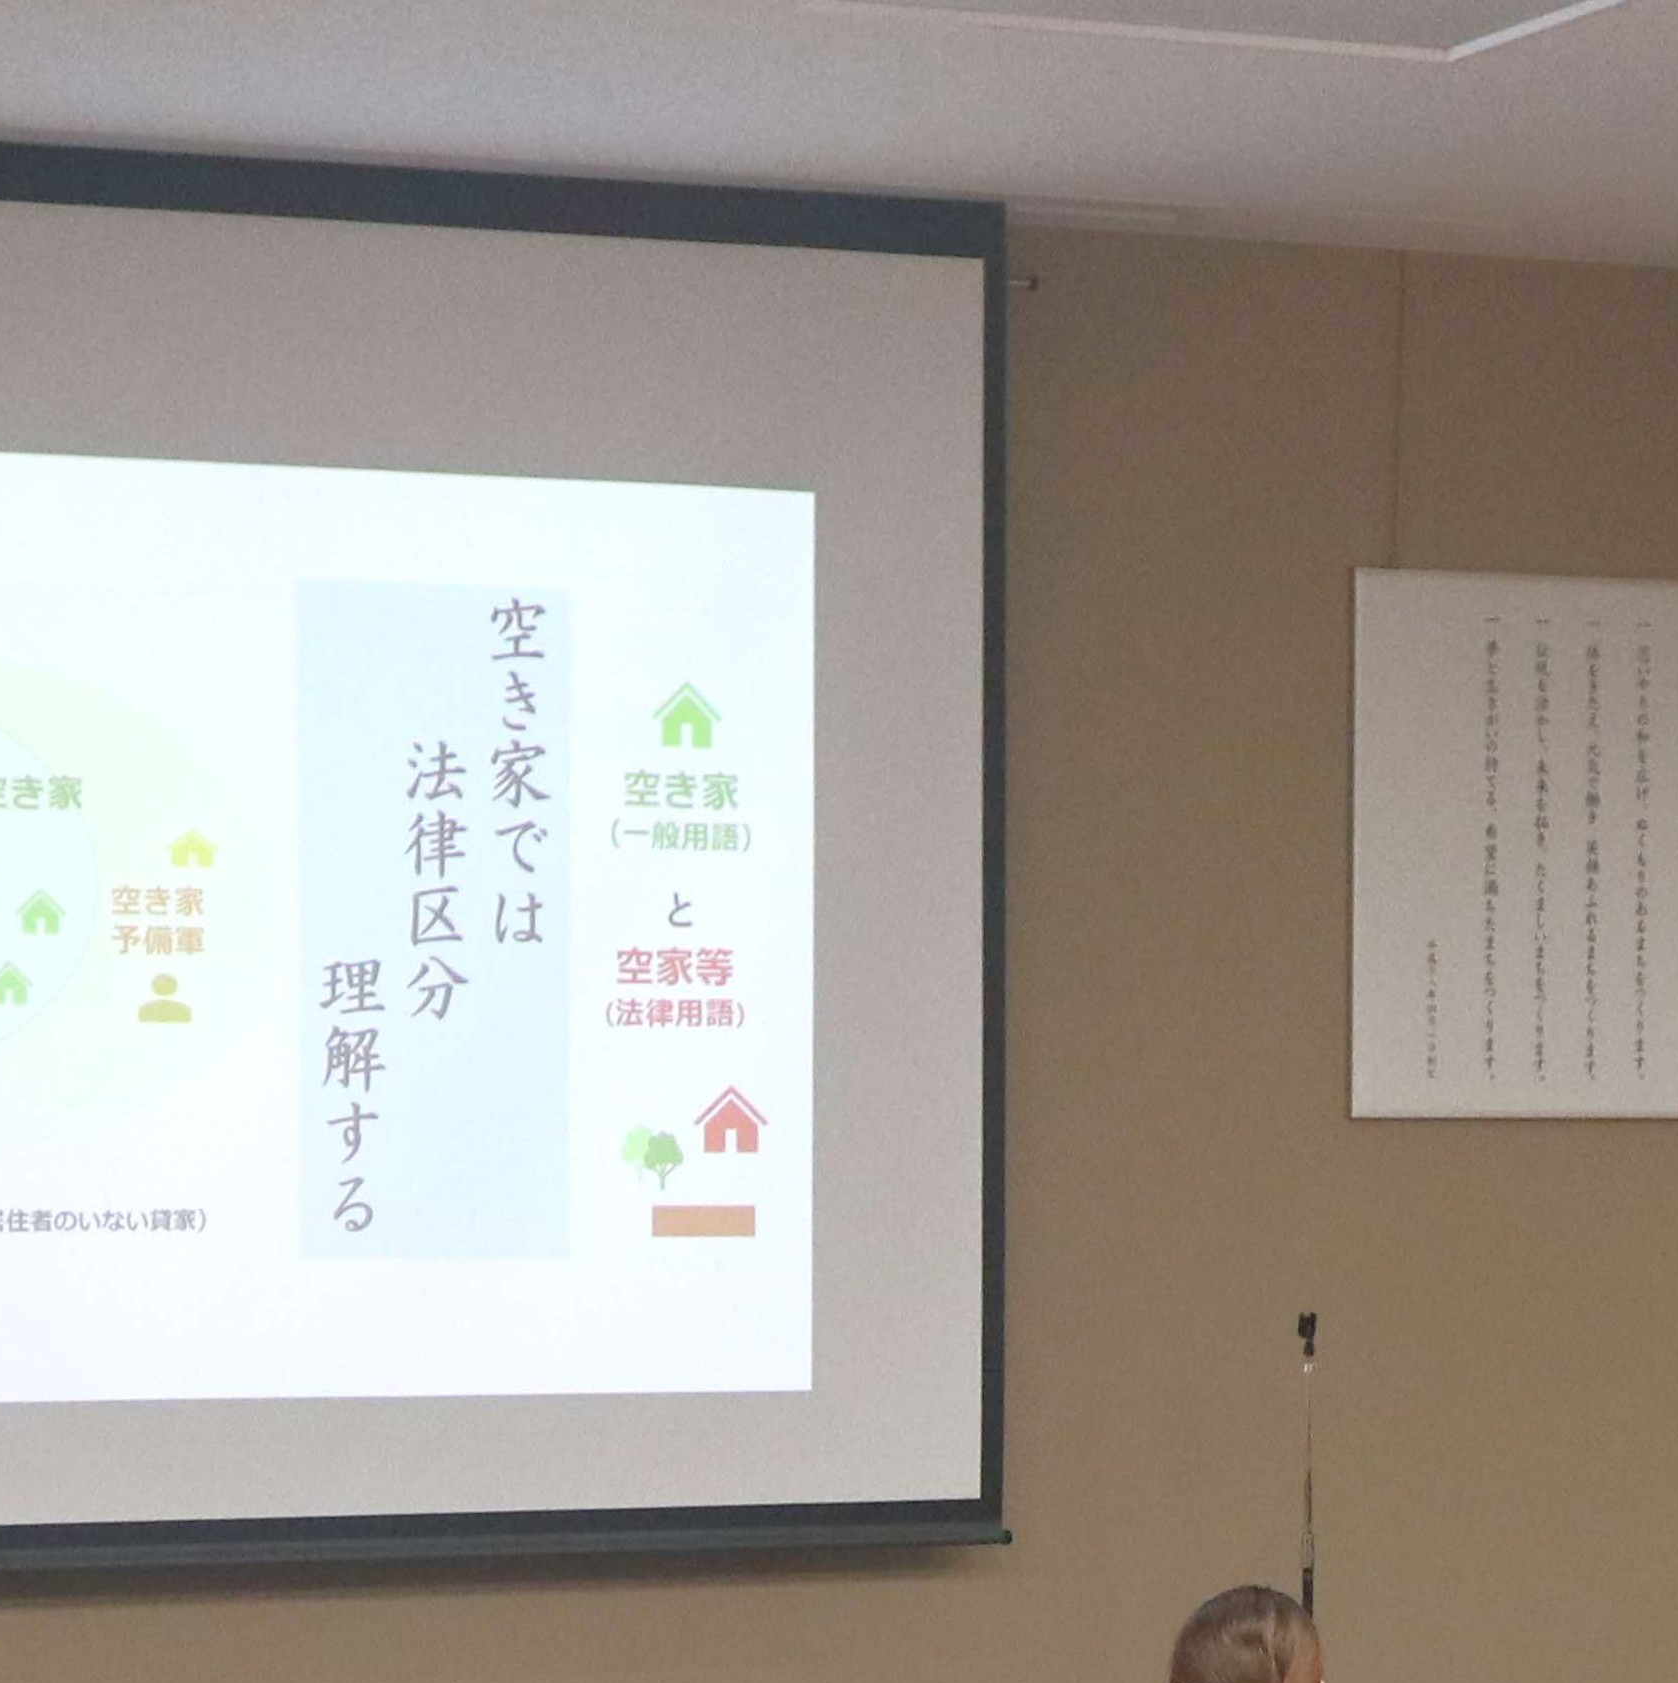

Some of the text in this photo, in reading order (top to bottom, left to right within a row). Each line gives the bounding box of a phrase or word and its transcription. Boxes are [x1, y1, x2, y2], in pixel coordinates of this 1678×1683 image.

[490, 598, 551, 944] 空き家では
[624, 770, 739, 811] 空き家
[112, 885, 204, 916] 空き家
[405, 741, 469, 1021] 法律区分
[667, 893, 693, 928] と
[112, 926, 204, 955] 予備軍
[616, 947, 734, 987] 空家等
[319, 959, 386, 1233] 理解する
